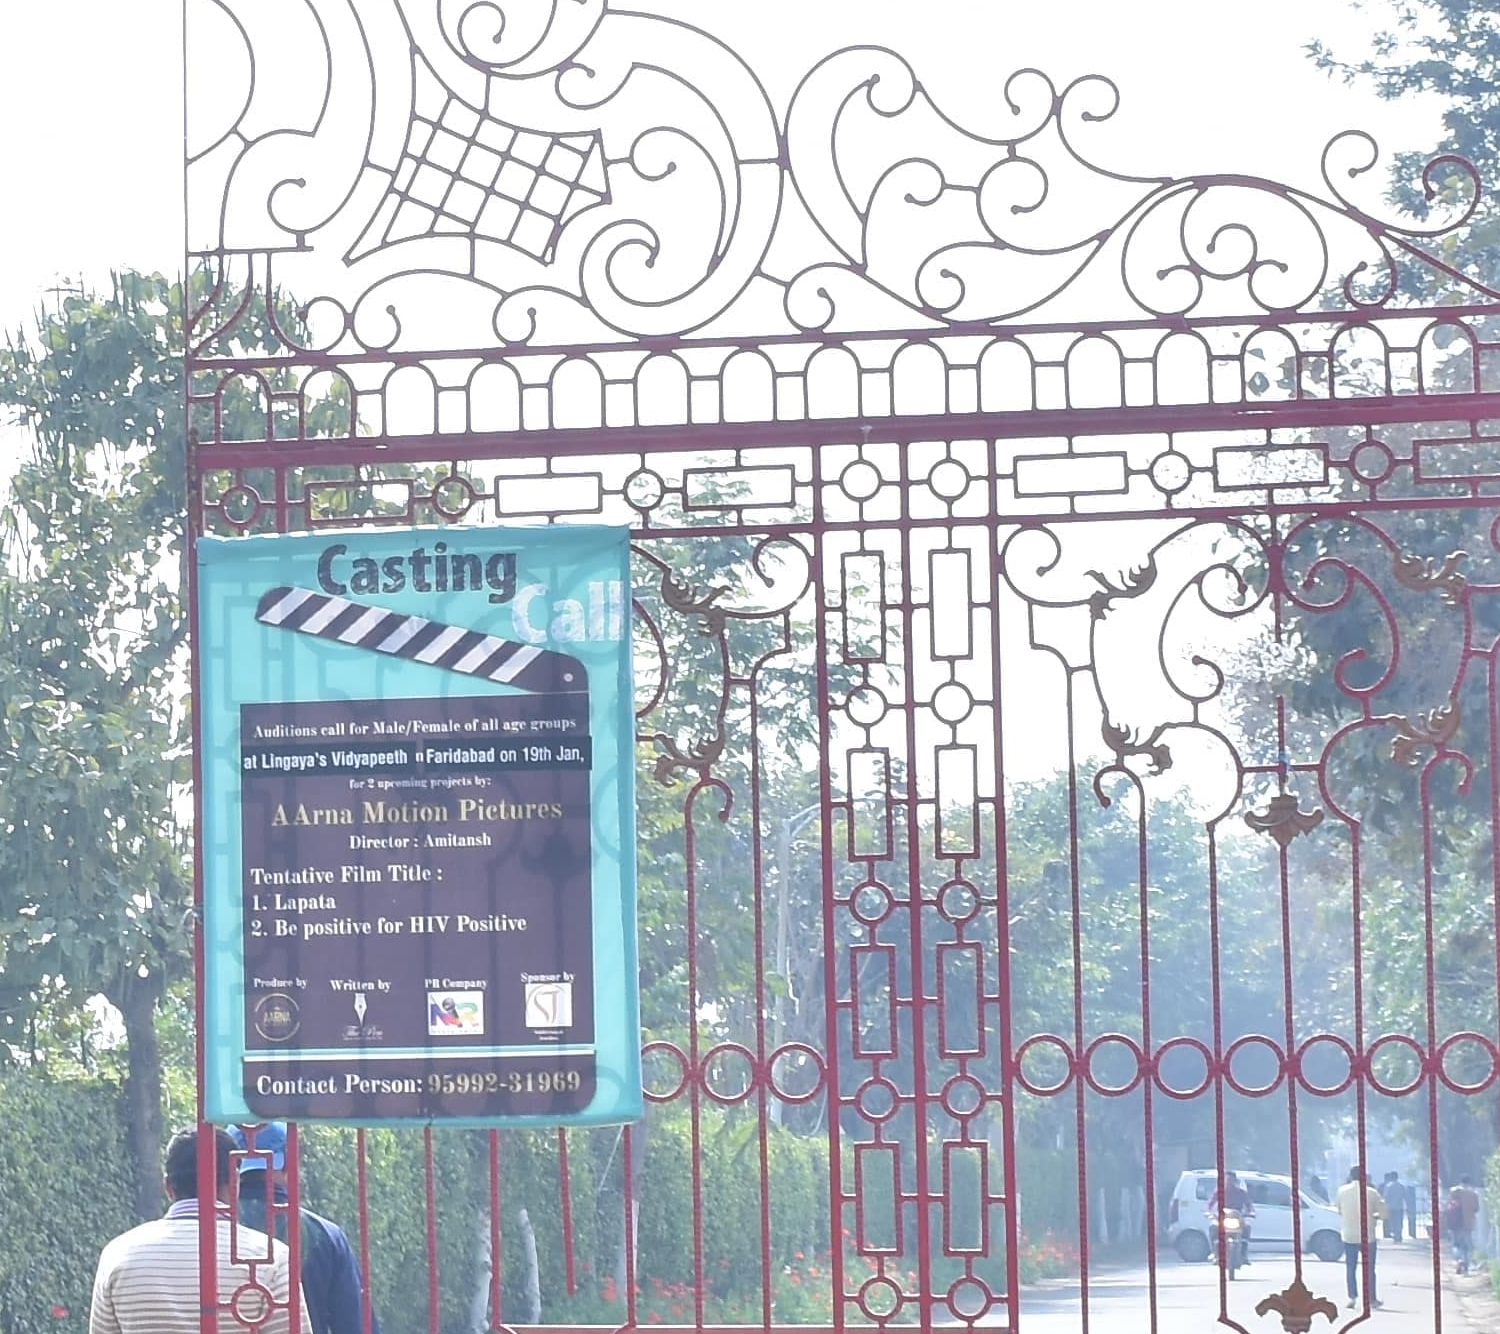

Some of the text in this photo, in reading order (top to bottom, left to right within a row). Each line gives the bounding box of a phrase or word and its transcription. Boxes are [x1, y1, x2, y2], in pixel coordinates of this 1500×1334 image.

[317, 542, 517, 604] Casting
[512, 581, 624, 643] Call
[253, 717, 577, 739] Auditions call for Male/Female of all age groups
[243, 754, 257, 769] at
[262, 752, 327, 771] Lingaya's
[331, 749, 408, 769] Vidyapeeth
[426, 746, 495, 764] Faridabad
[499, 750, 517, 763] on
[522, 746, 552, 762] 19th
[556, 745, 585, 763] Jan,
[349, 778, 365, 789] for
[367, 778, 375, 789] 2
[430, 776, 472, 790] projects
[474, 775, 492, 788] by:
[362, 799, 448, 825] Motion
[458, 798, 563, 822] Pictures
[349, 834, 410, 850] Director
[423, 832, 492, 848] Amitansh
[250, 867, 334, 885] Tentative
[340, 865, 382, 883] Film
[387, 864, 432, 882] Title
[252, 893, 336, 914] 1. Lapata
[251, 914, 527, 940] 2. Be positive for HIV Positive
[253, 977, 308, 989] Produce by
[330, 979, 391, 992] Written by
[442, 978, 488, 990] Company
[520, 971, 576, 984] Sponsor by
[256, 1071, 581, 1095] Contact Person: 95992-31969
